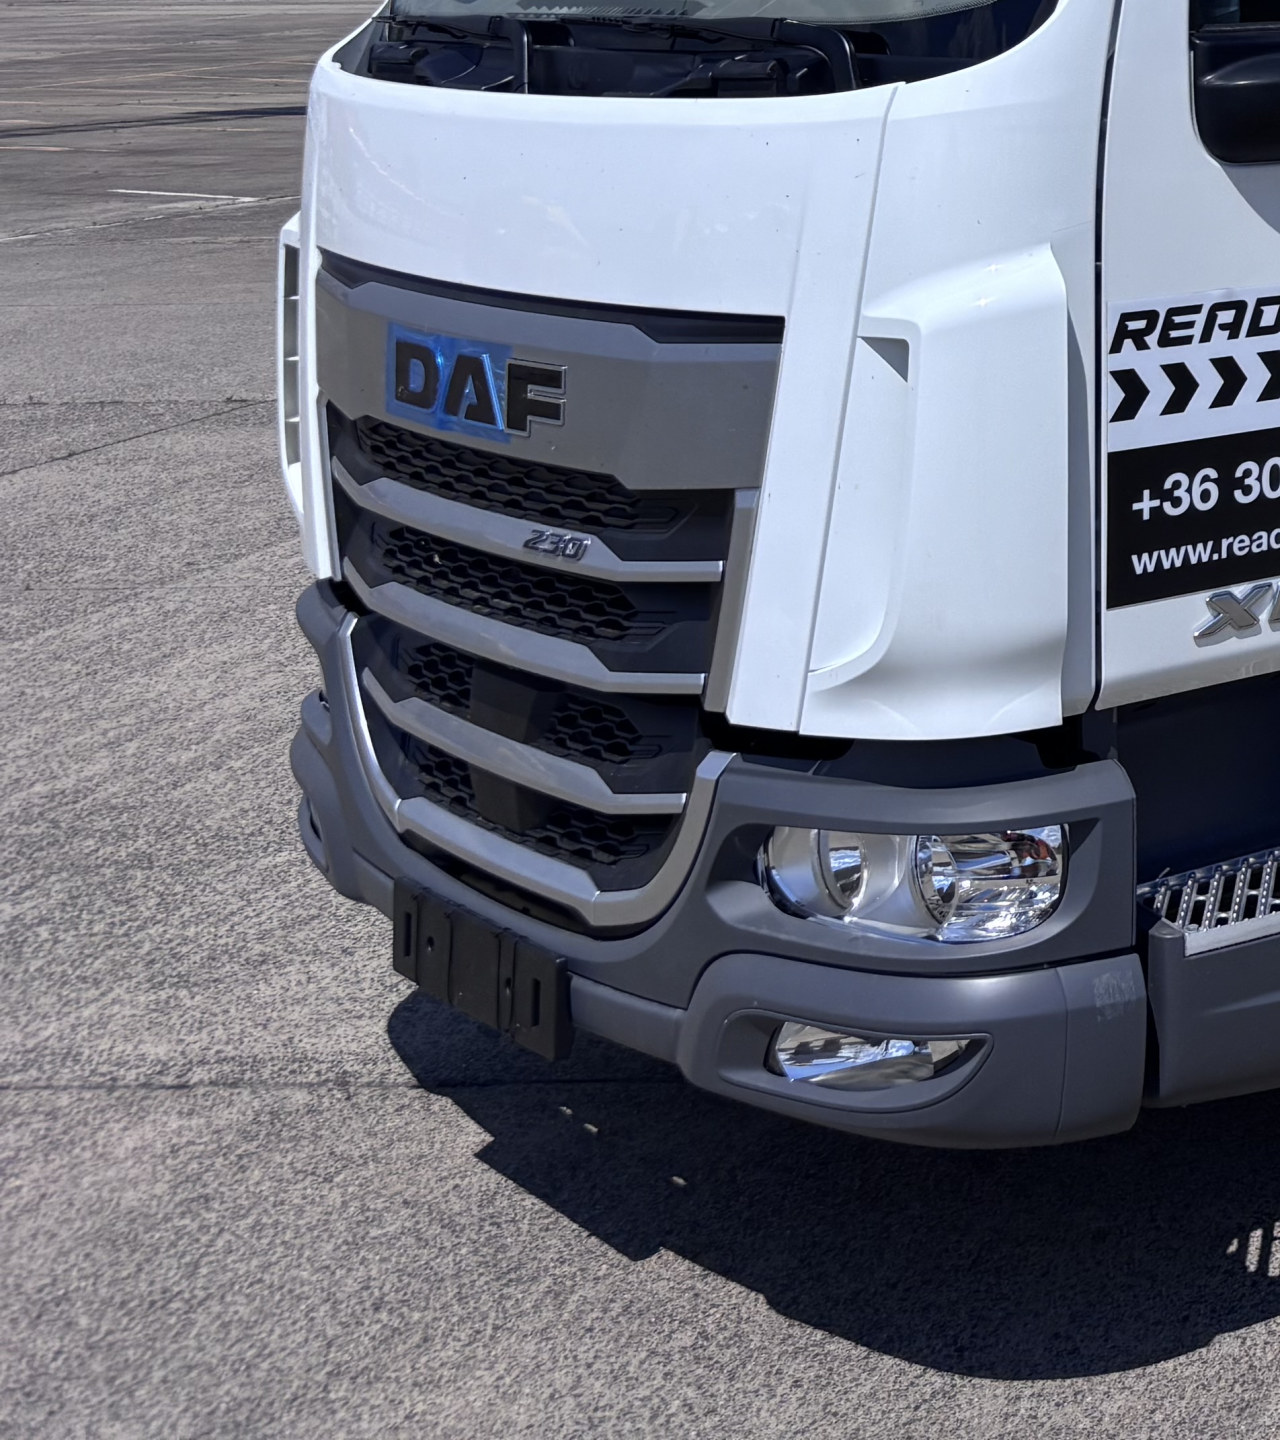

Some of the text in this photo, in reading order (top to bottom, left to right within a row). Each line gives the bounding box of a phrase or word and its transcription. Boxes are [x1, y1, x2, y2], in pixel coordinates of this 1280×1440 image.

[394, 337, 568, 438] DAF
[1131, 467, 1219, 521] +36
[523, 529, 591, 561] 230
